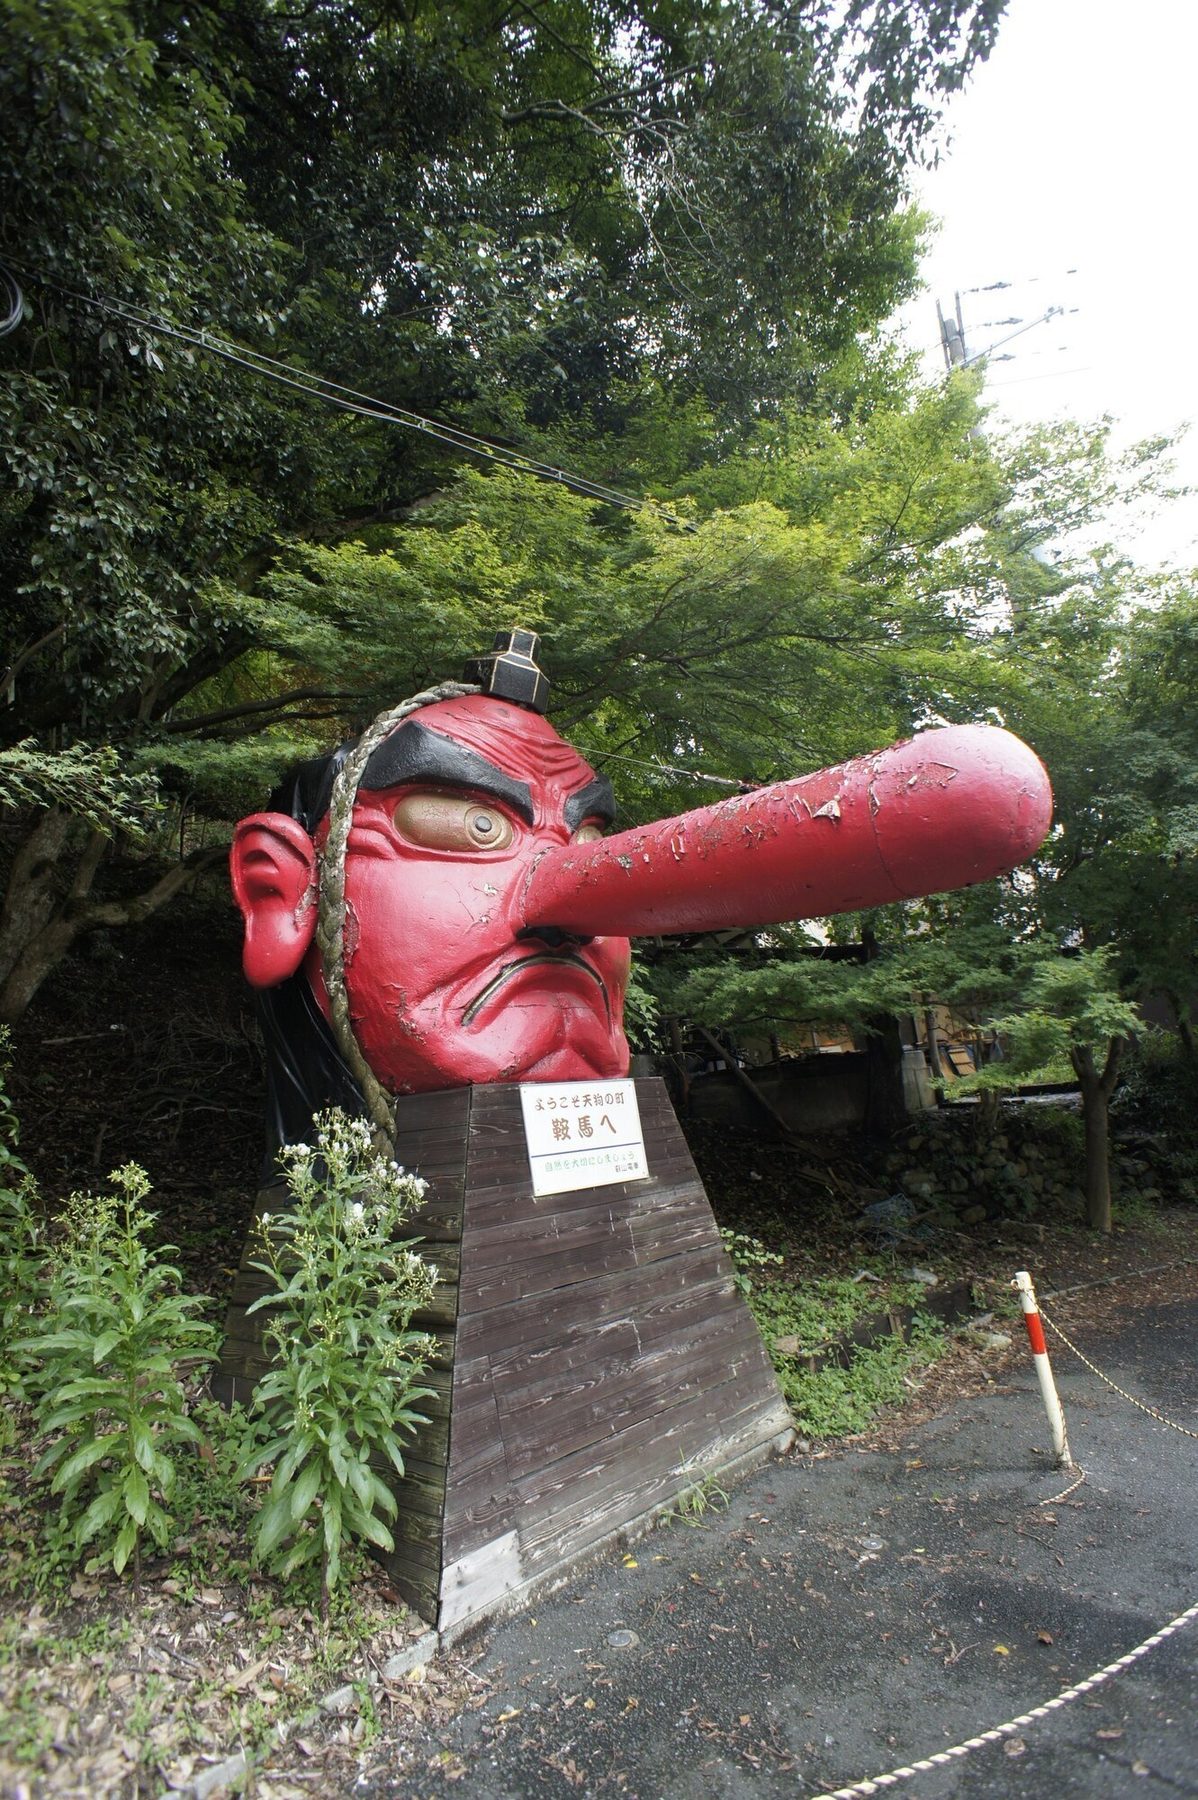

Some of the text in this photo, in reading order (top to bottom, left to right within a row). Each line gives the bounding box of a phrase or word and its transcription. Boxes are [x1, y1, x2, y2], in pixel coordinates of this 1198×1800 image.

[535, 1092, 624, 1111] ようこそ天狗の町
[552, 1115, 617, 1141] 鞍馬へ
[545, 1151, 635, 1172] 自然を大切にしましょう
